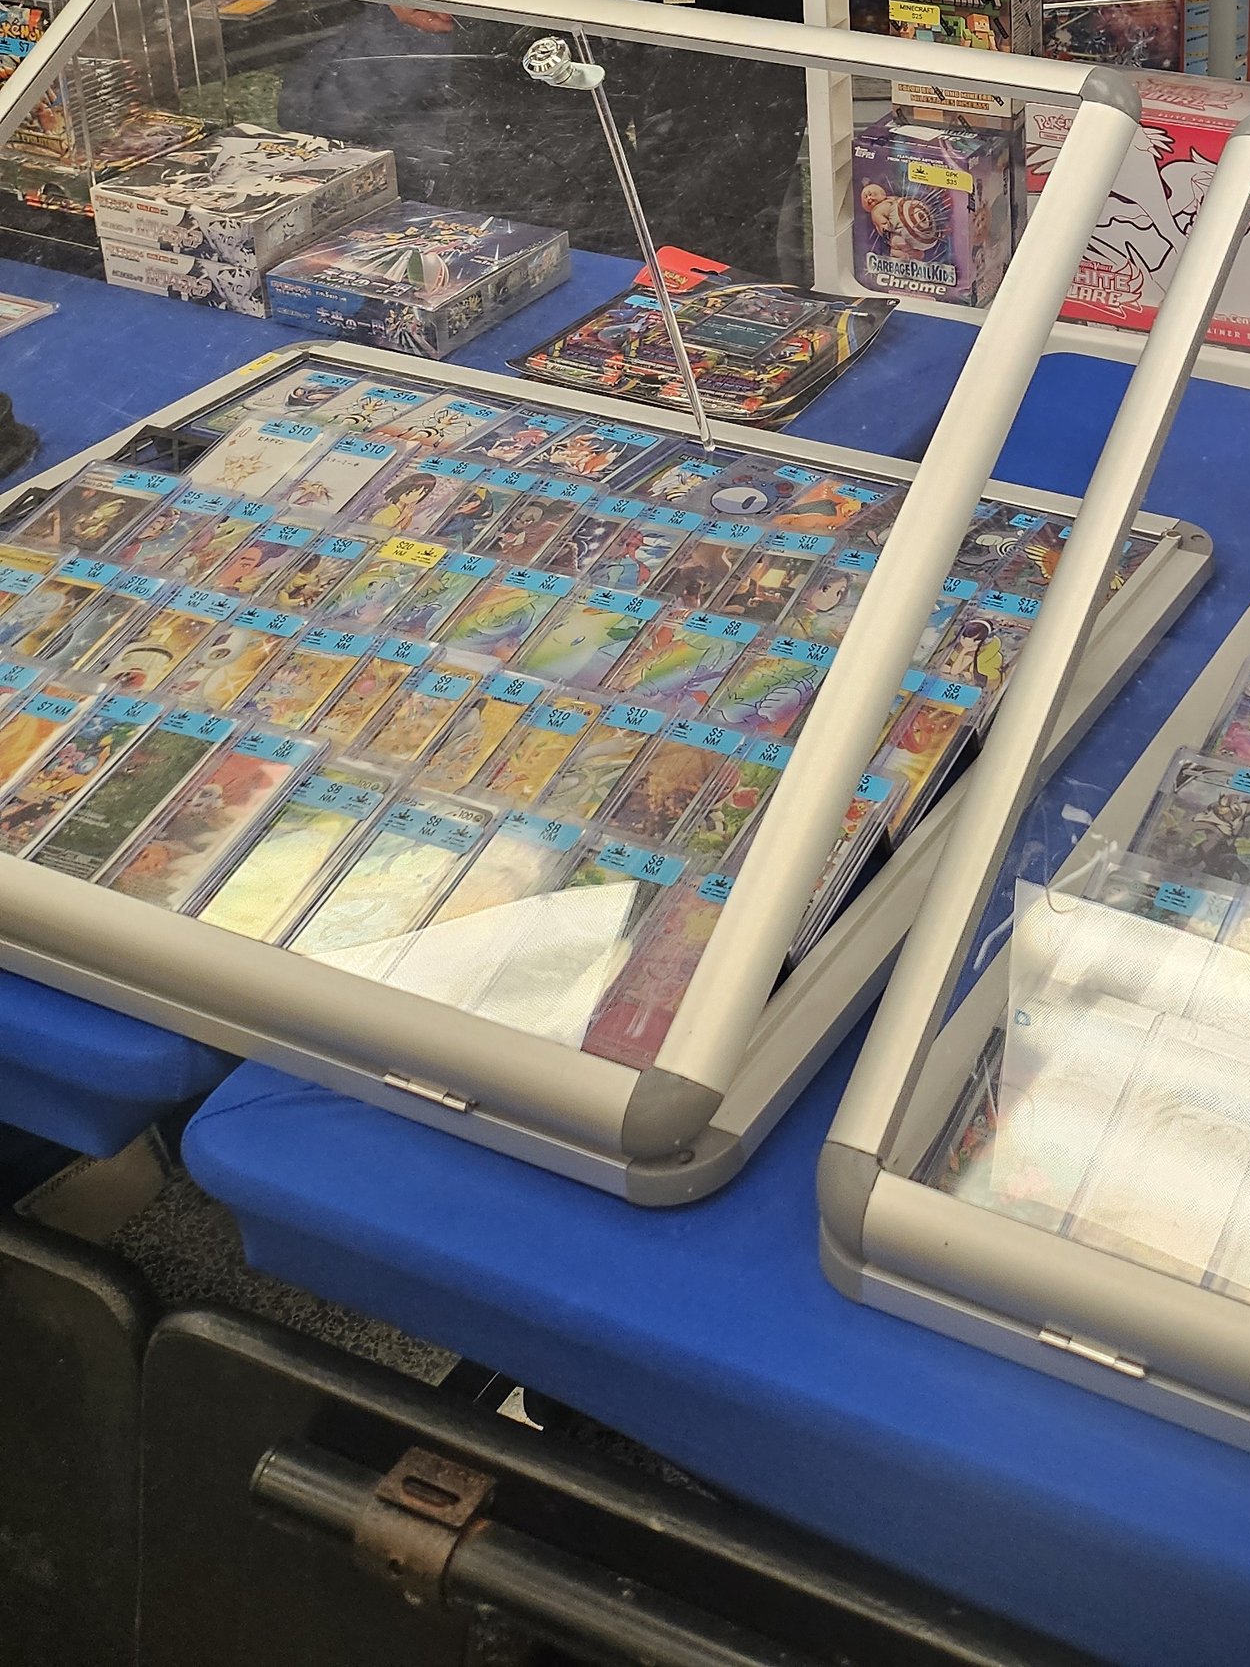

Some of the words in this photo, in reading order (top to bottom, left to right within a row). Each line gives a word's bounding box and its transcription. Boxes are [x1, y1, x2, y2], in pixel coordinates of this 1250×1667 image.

[900, 5, 934, 14] MINECRAFT
[946, 171, 958, 179] GPK
[946, 178, 958, 186] $35
[876, 274, 947, 295] Chrome
[1076, 269, 1131, 291] HITE
[288, 424, 313, 436] $10
[361, 442, 386, 455] $10
[1018, 596, 1039, 608] $12
